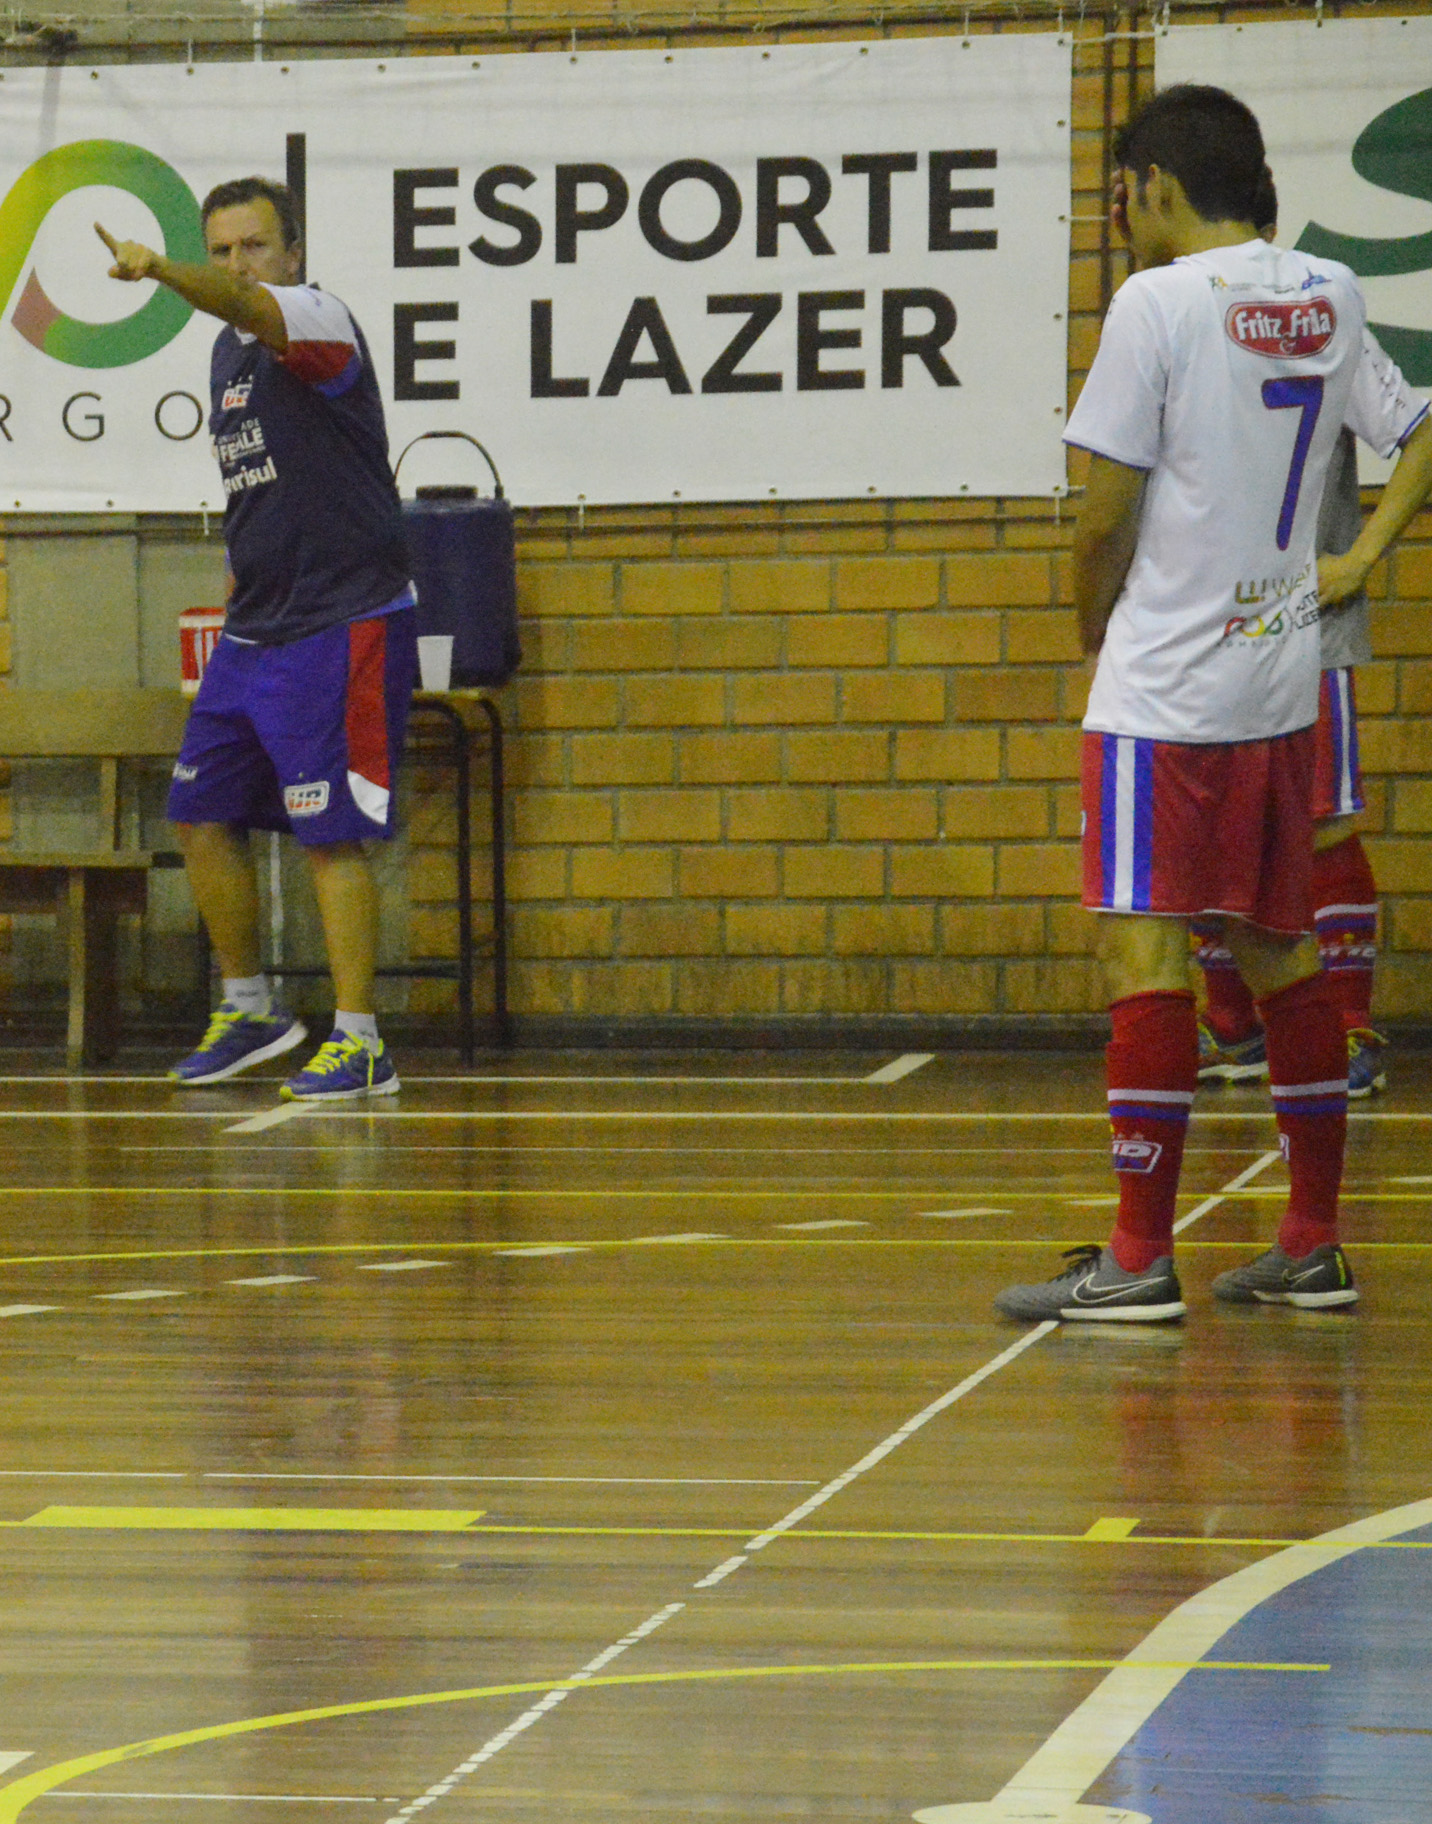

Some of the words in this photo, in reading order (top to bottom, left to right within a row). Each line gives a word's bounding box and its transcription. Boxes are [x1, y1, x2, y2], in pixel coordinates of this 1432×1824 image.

[393, 149, 998, 269] ESPORTE
[393, 301, 460, 401] E
[530, 287, 962, 399] LAZER
[1260, 374, 1325, 553] 7
